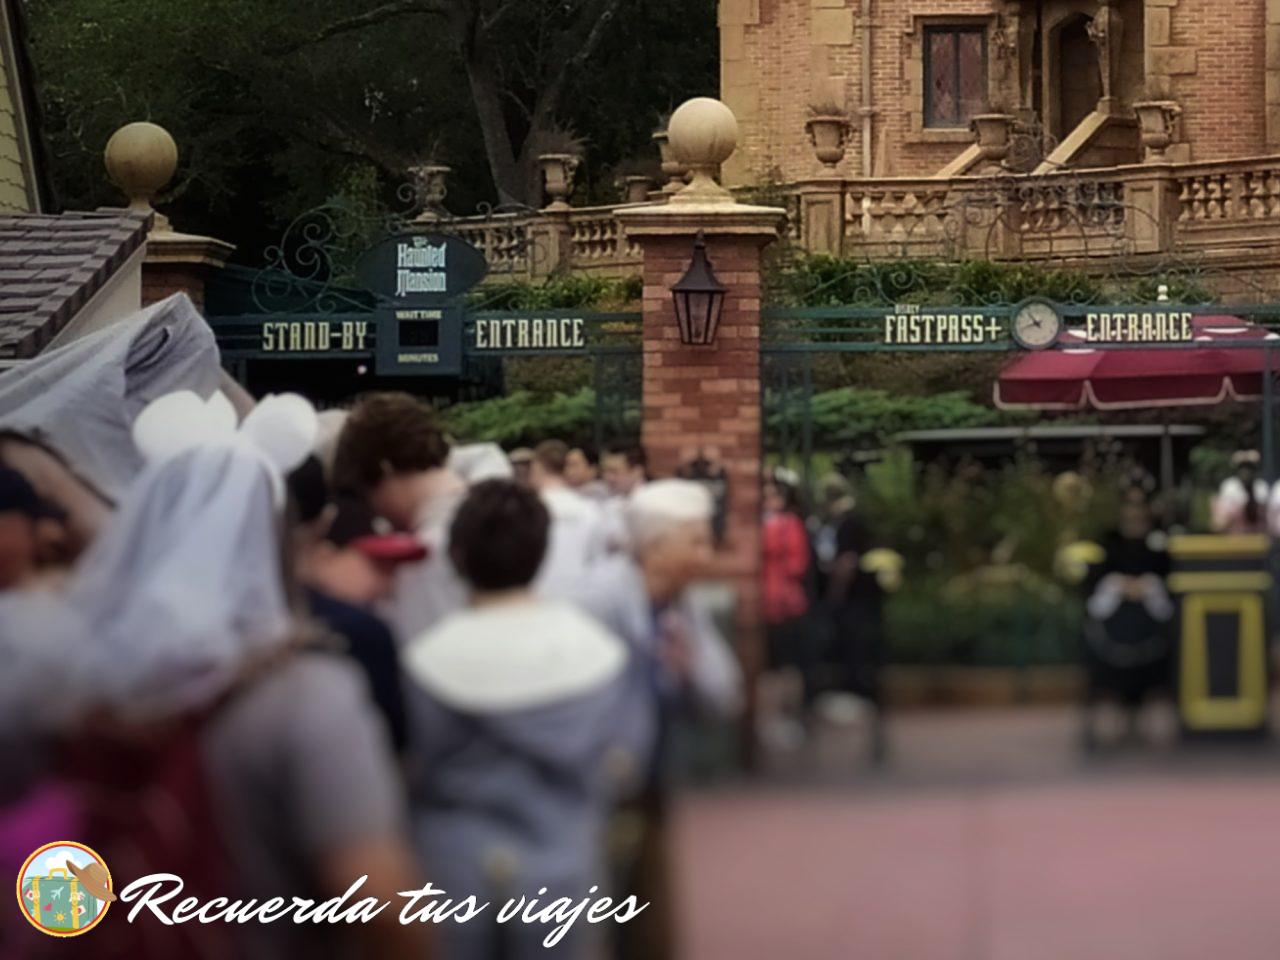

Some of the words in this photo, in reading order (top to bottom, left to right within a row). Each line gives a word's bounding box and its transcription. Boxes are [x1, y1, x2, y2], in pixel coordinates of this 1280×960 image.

[397, 242, 447, 267] Haunted
[395, 268, 446, 297] Mansion
[262, 321, 367, 351] STAND-BY
[476, 319, 584, 348] ENTRANCE
[885, 314, 1002, 343] FASTPASS+
[1086, 312, 1193, 341] ENTRANCE
